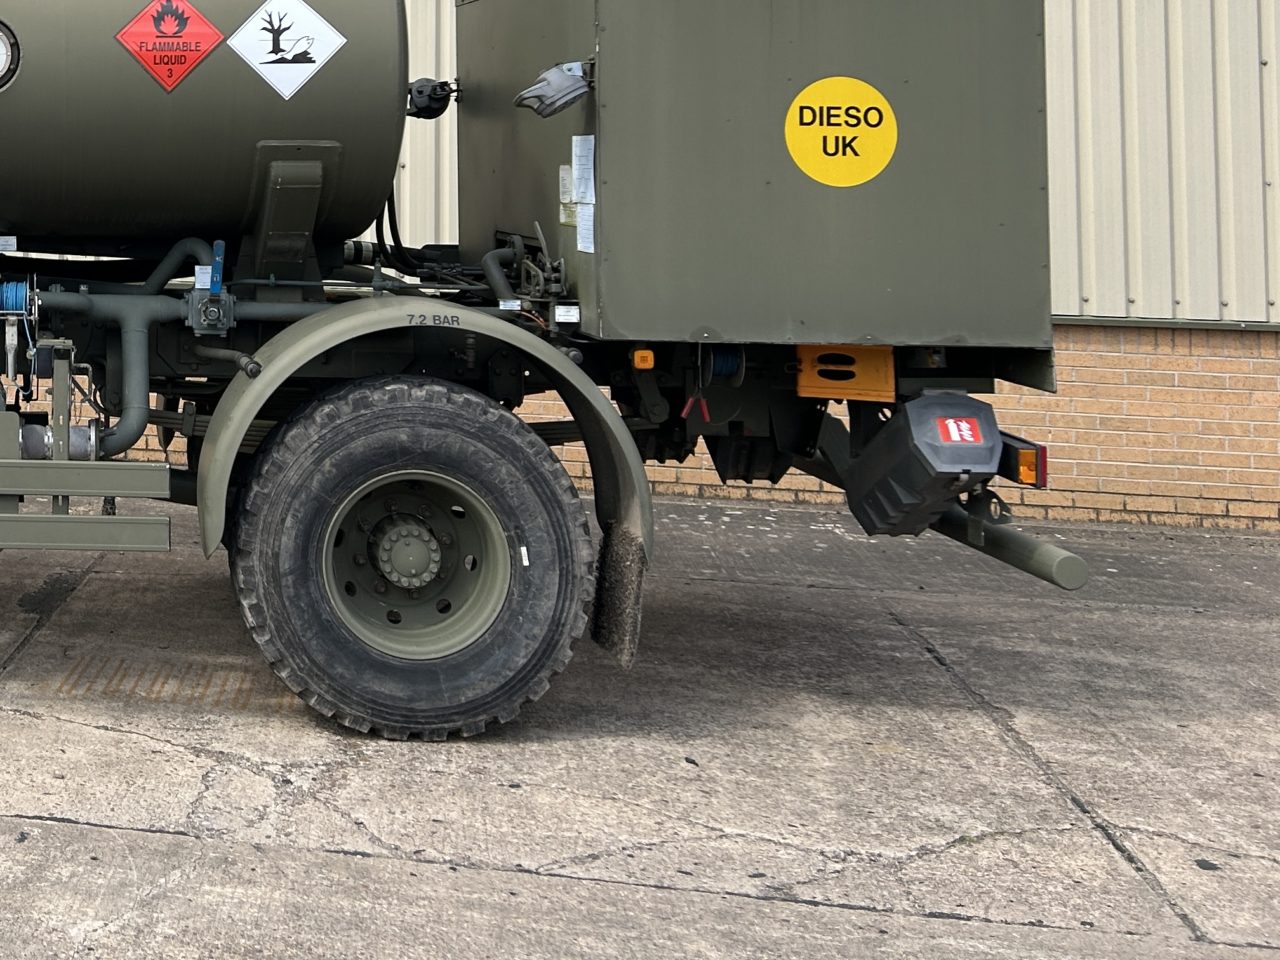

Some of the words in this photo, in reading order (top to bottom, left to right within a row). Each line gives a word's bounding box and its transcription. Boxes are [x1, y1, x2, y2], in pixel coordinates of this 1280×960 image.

[138, 41, 202, 53] FLAMMABLE
[152, 54, 188, 66] LIQUID
[166, 68, 174, 79] 3
[798, 105, 884, 129] DIESO
[822, 135, 861, 157] UK
[406, 314, 428, 326] 7.2
[432, 314, 461, 326] BAR
